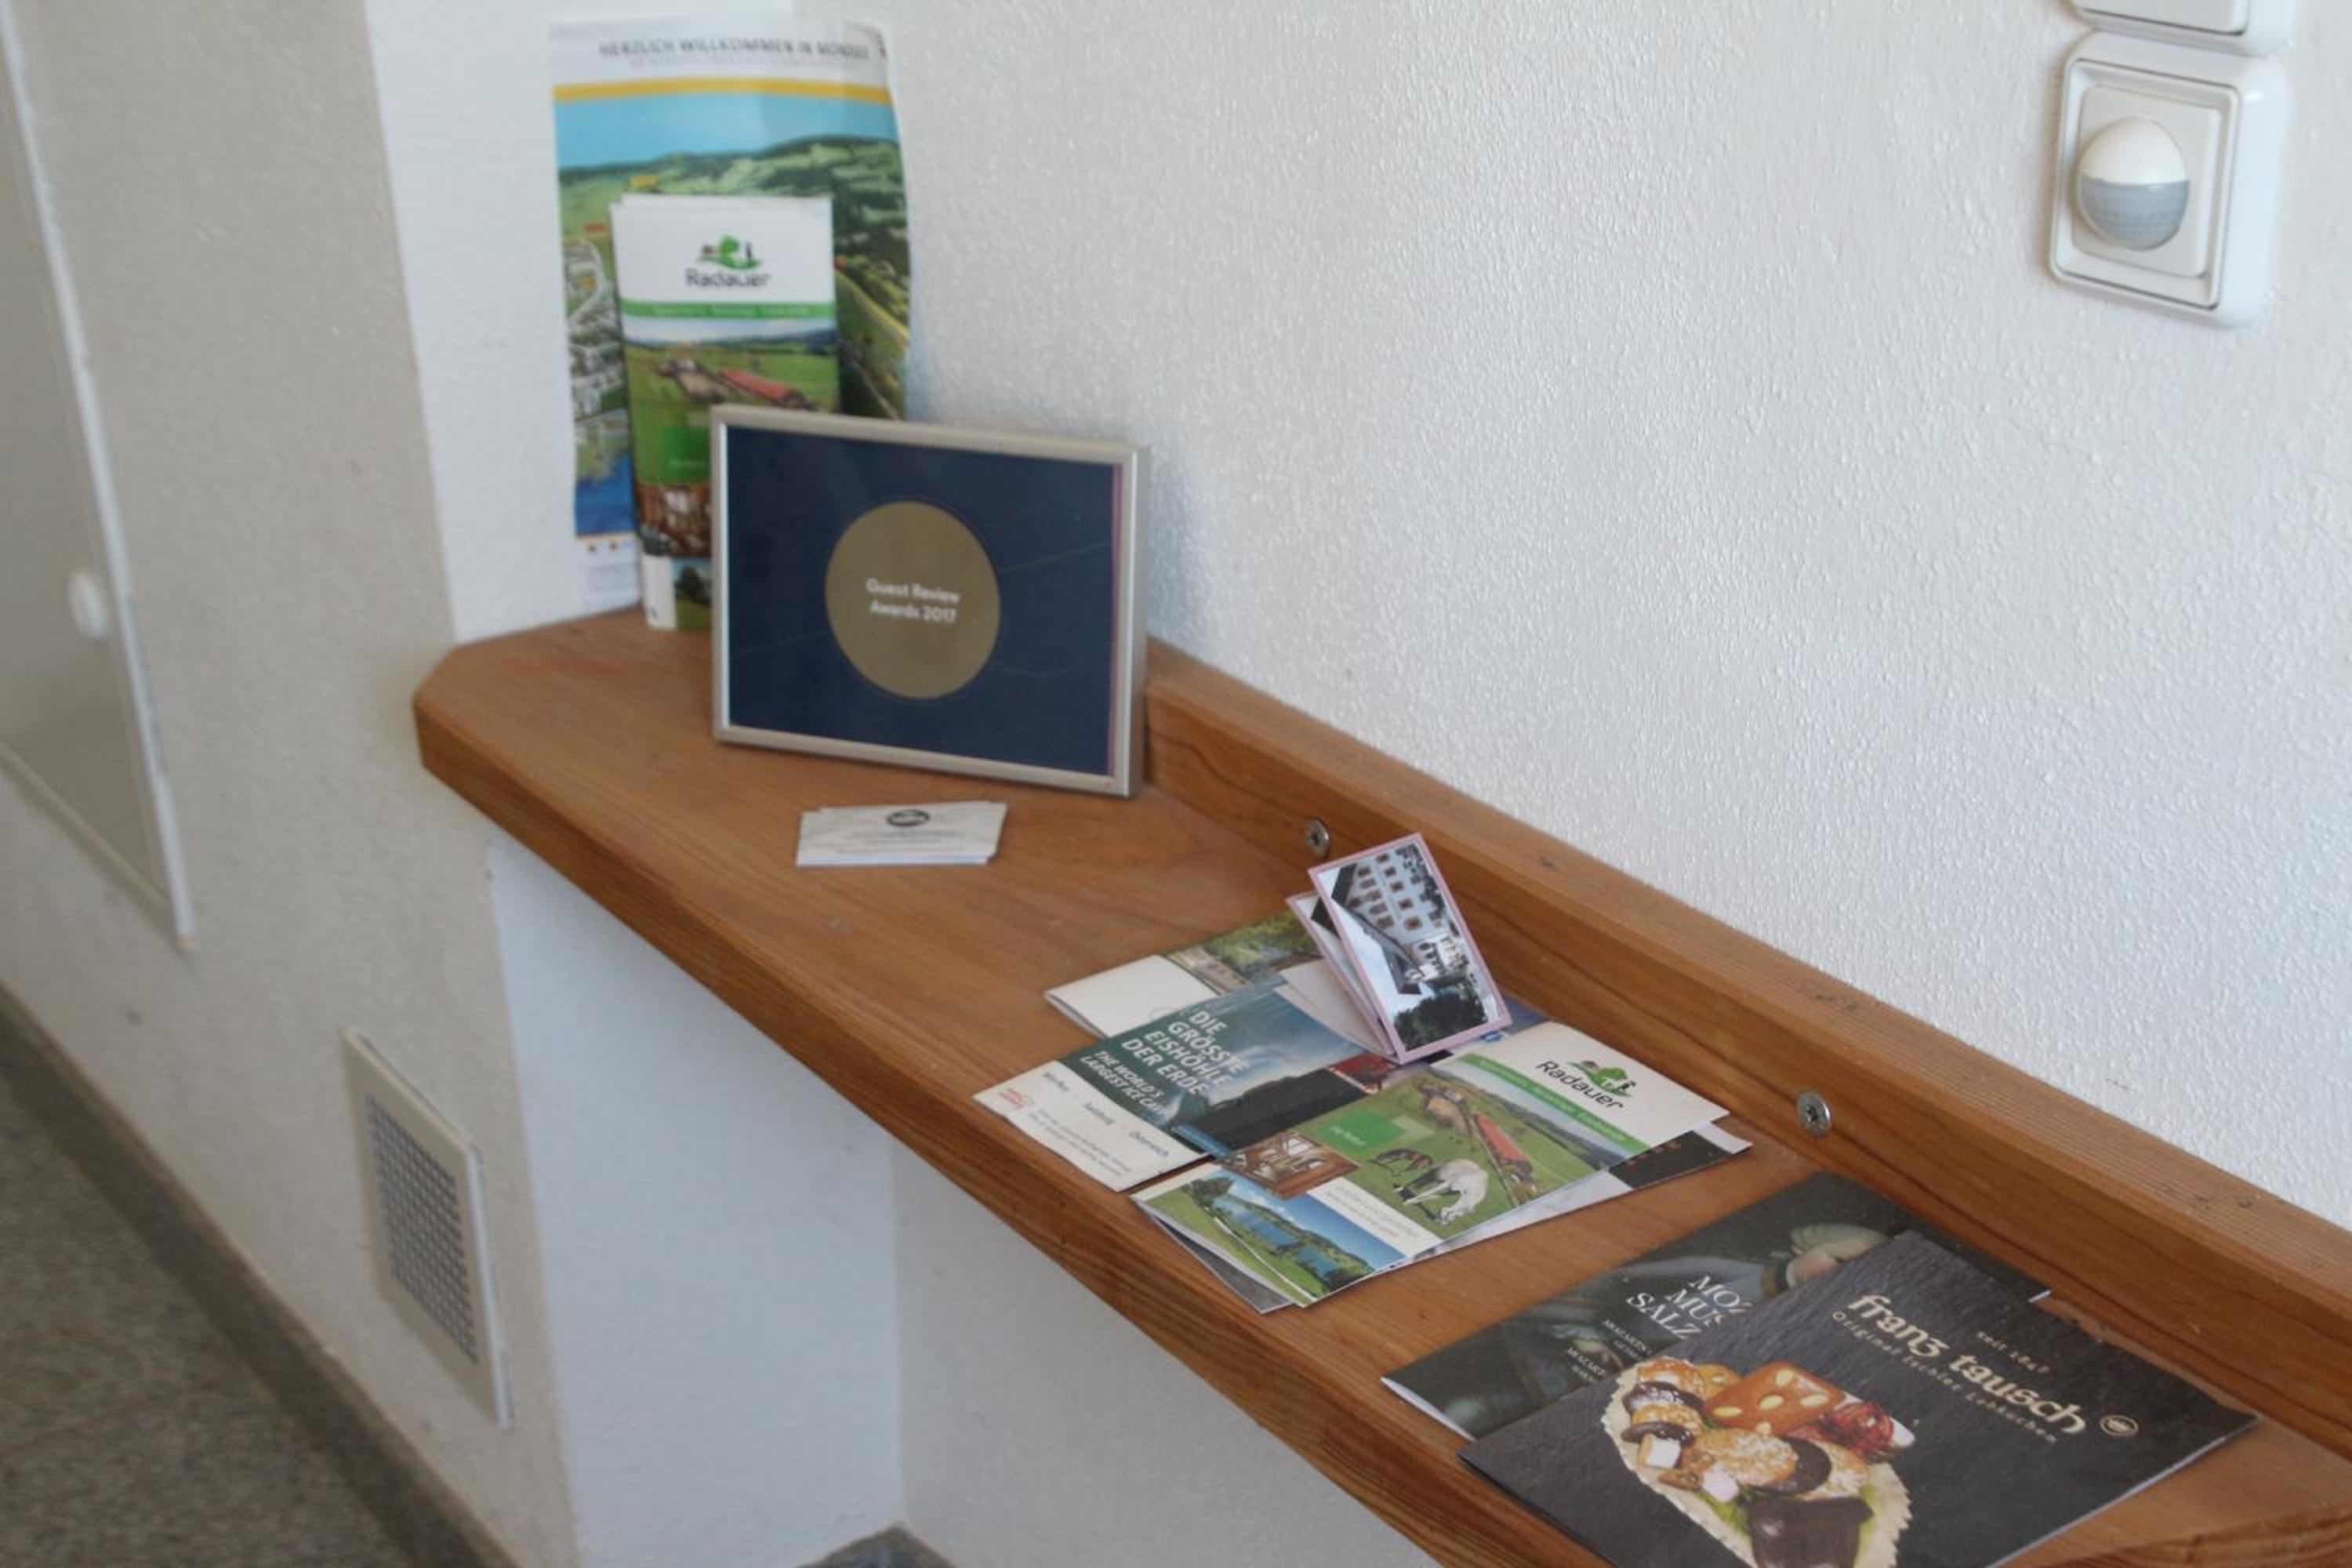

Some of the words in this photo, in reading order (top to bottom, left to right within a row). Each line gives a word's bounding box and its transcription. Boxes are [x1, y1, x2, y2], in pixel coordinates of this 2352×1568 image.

[685, 267, 772, 287] Radauer
[866, 578, 909, 597] Guest
[912, 583, 961, 603] Review
[869, 599, 920, 619] Awards
[924, 604, 956, 624] 2017
[1189, 1010, 1228, 1036] DIE
[1094, 1051, 1120, 1066] THE
[1120, 1038, 1164, 1067] DER
[1156, 1063, 1209, 1095] ERDE
[1145, 1030, 1232, 1087] EISHÖHLE
[1167, 1021, 1250, 1074] GRÖSSTE
[1080, 1056, 1130, 1088] LARGEST
[1123, 1087, 1144, 1099] ICE
[1537, 1061, 1624, 1109] Radauer
[1847, 1295, 1950, 1356] franz
[1949, 1355, 2086, 1432] tausch
